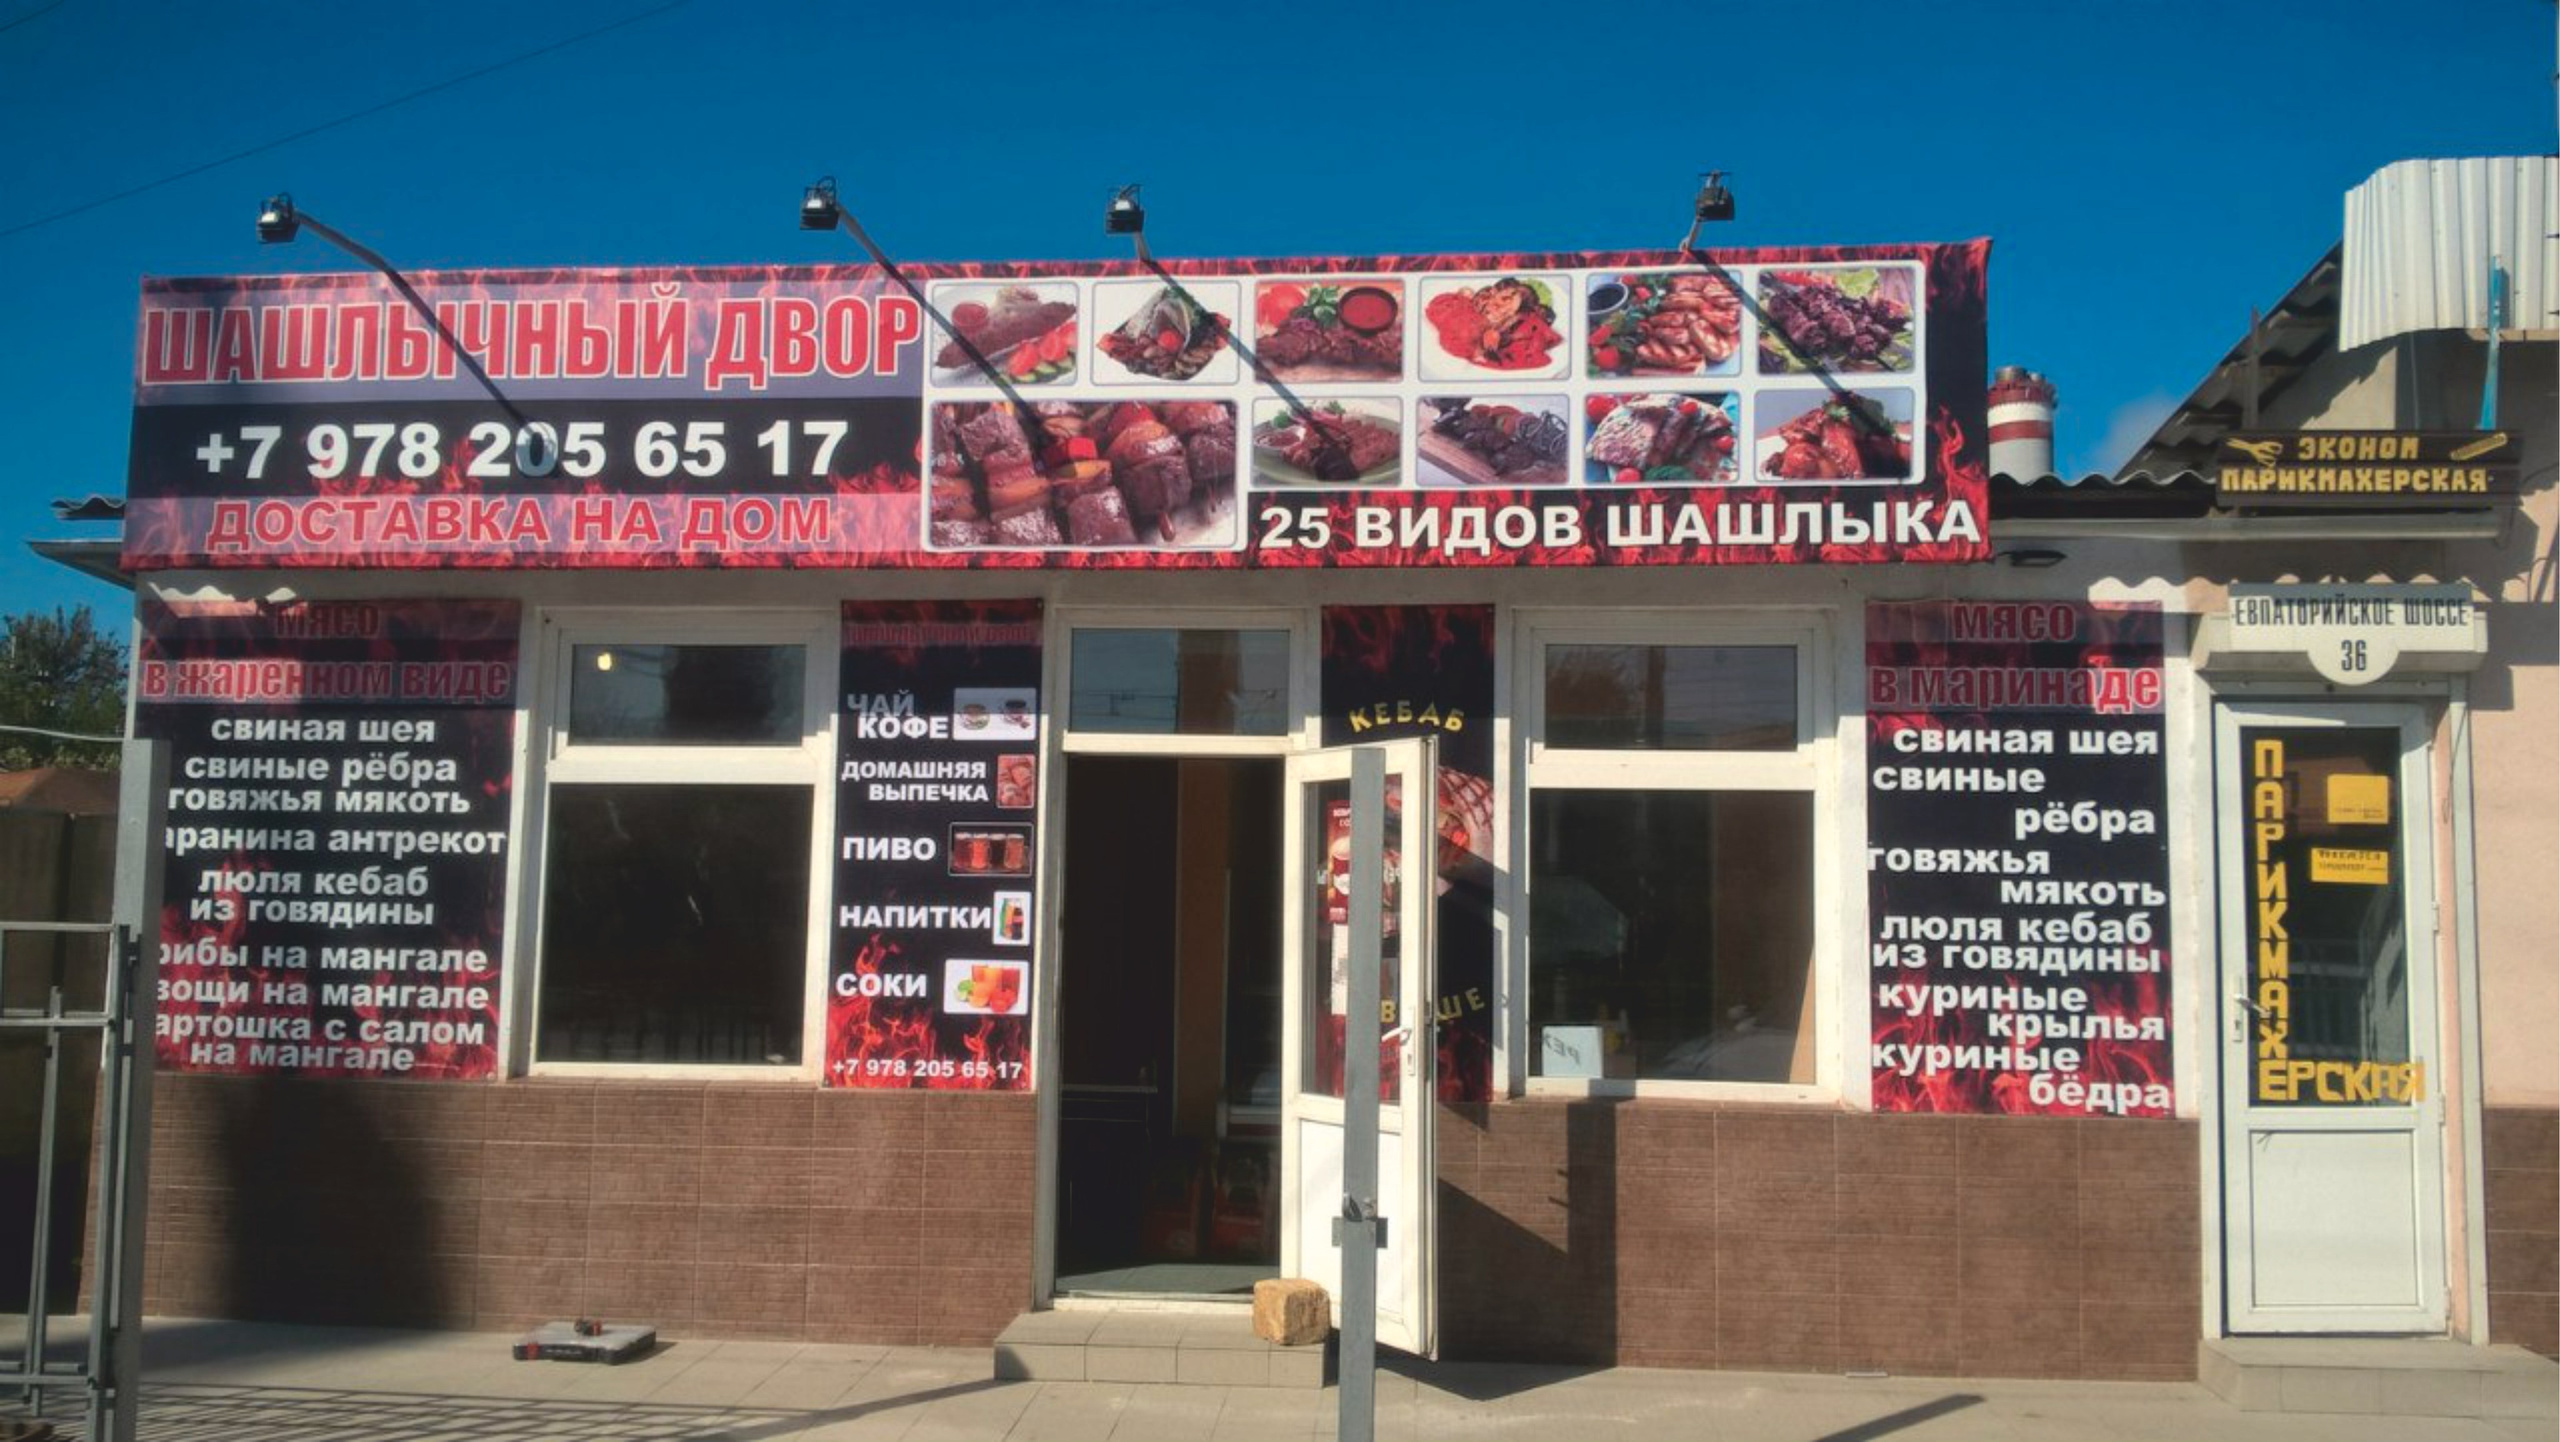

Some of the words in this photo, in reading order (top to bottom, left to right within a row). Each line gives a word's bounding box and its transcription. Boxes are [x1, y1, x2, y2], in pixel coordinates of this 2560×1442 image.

[142, 282, 688, 386] ШАШЛЫЧНЫЙ
[706, 292, 921, 391] ДВОР
[196, 425, 282, 479] +7
[305, 421, 440, 479] 978
[467, 420, 606, 479] 205
[633, 421, 725, 477] 65
[756, 420, 850, 476] 17
[2298, 436, 2419, 460] ЭКОНОМ
[2222, 467, 2487, 492] ПАРИКМАХЕРСКАЯ
[205, 498, 551, 552] ДОСТАВКА
[573, 498, 664, 545] НА
[679, 497, 832, 551] ДОМ
[1259, 507, 1333, 549] 25
[1355, 505, 1582, 557] ВИДОВ
[1605, 500, 1981, 546] ШАШЛЫКА
[2235, 594, 2395, 625] ЕВПАТОРИЙСКОЕ
[2404, 598, 2468, 625] ШОССЕ
[2341, 640, 2367, 671] 36
[175, 660, 392, 700] жаренном
[402, 660, 510, 704] виде
[1909, 667, 2161, 714] маринаде
[848, 690, 915, 716] ЧАЙ
[1349, 700, 1464, 733] КЕБАБ
[211, 718, 345, 742] свиная
[358, 719, 435, 743] шея
[857, 716, 948, 739] КОФЕ
[1893, 729, 2054, 753] свиная
[2069, 730, 2158, 754] шея
[185, 755, 329, 780] свиные
[342, 752, 456, 788] рёбра
[841, 761, 986, 781] ДОМАШНЯЯ
[1873, 767, 2045, 792] свиные
[168, 786, 322, 812] говяжья
[335, 790, 470, 813] мякоть
[869, 784, 989, 802] ВЫПЕЧКА
[2015, 801, 2155, 841] рёбра
[328, 830, 507, 860] антрекот
[843, 837, 936, 861] ПИВО
[1868, 848, 2050, 874] говяжья
[198, 869, 301, 895] люля
[314, 866, 428, 896] кебаб
[2001, 881, 2166, 906] мякоть
[190, 898, 235, 921] из
[249, 902, 434, 928] говядины
[839, 905, 991, 929] НАПИТКИ
[1881, 916, 2003, 940] люля
[2018, 912, 2152, 944] кебаб
[262, 947, 307, 969] на
[321, 947, 488, 971] мангале
[1873, 944, 1926, 969] из
[1943, 945, 2161, 977] говядины
[264, 982, 308, 1005] на
[321, 983, 489, 1009] мангале
[835, 973, 927, 997] СОКИ
[1879, 984, 2088, 1017] куриные
[155, 1013, 310, 1043] артошка
[325, 1018, 346, 1039] с
[359, 1018, 484, 1045] салом
[1988, 1013, 2165, 1044] крылья
[191, 1042, 235, 1064] на
[249, 1045, 415, 1071] мангале
[832, 1059, 860, 1075] +7
[866, 1059, 907, 1076] 978
[914, 1060, 954, 1077] 205
[961, 1061, 988, 1078] 65
[996, 1061, 1023, 1079] 17
[1872, 1043, 2080, 1076] куриные
[2030, 1073, 2170, 1114] бёдра
